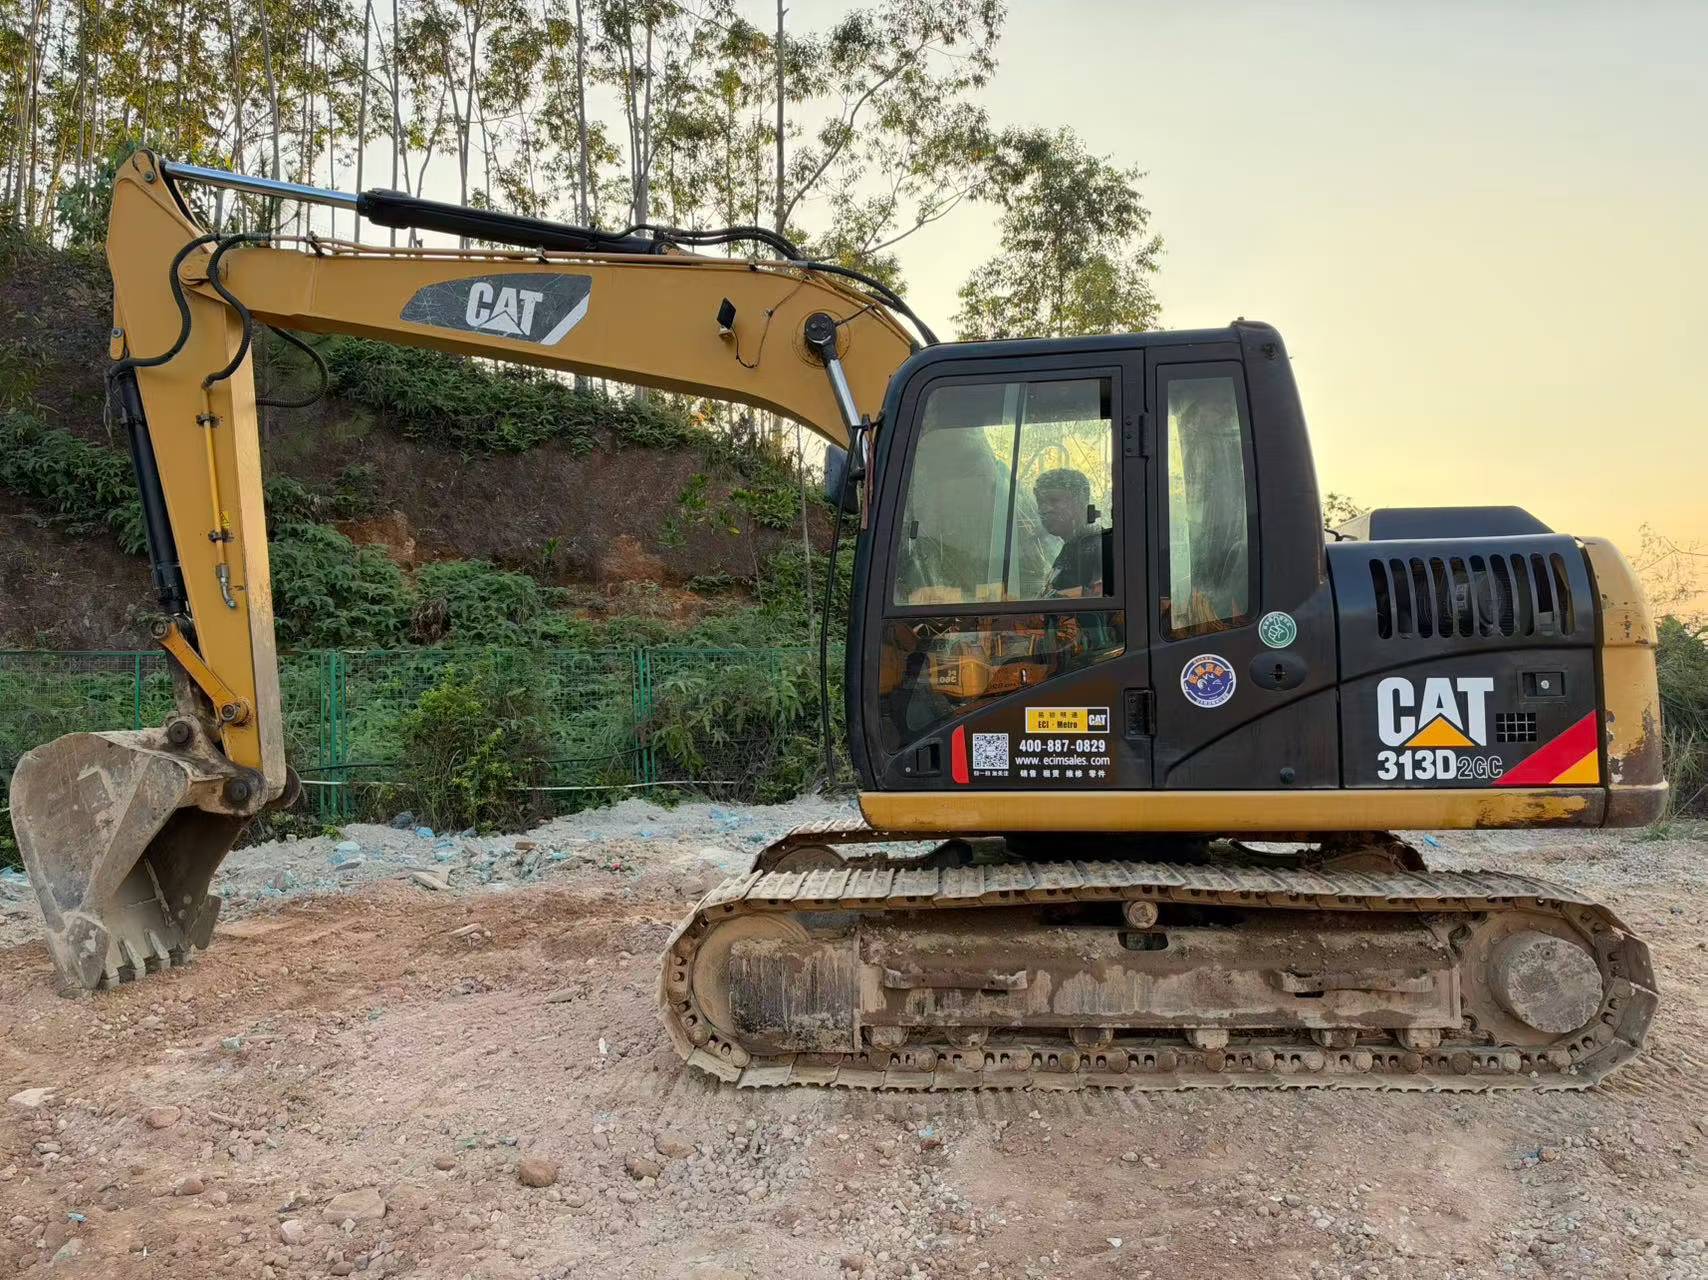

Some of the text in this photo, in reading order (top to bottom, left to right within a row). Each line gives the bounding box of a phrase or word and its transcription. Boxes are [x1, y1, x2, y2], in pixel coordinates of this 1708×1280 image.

[465, 282, 543, 336] CAT
[1377, 676, 1494, 747] CAT
[1038, 721, 1078, 729] ECI Metro
[1088, 714, 1106, 726] CAT
[1019, 739, 1106, 753] 400-887-0829
[1088, 769, 1106, 778] 零件
